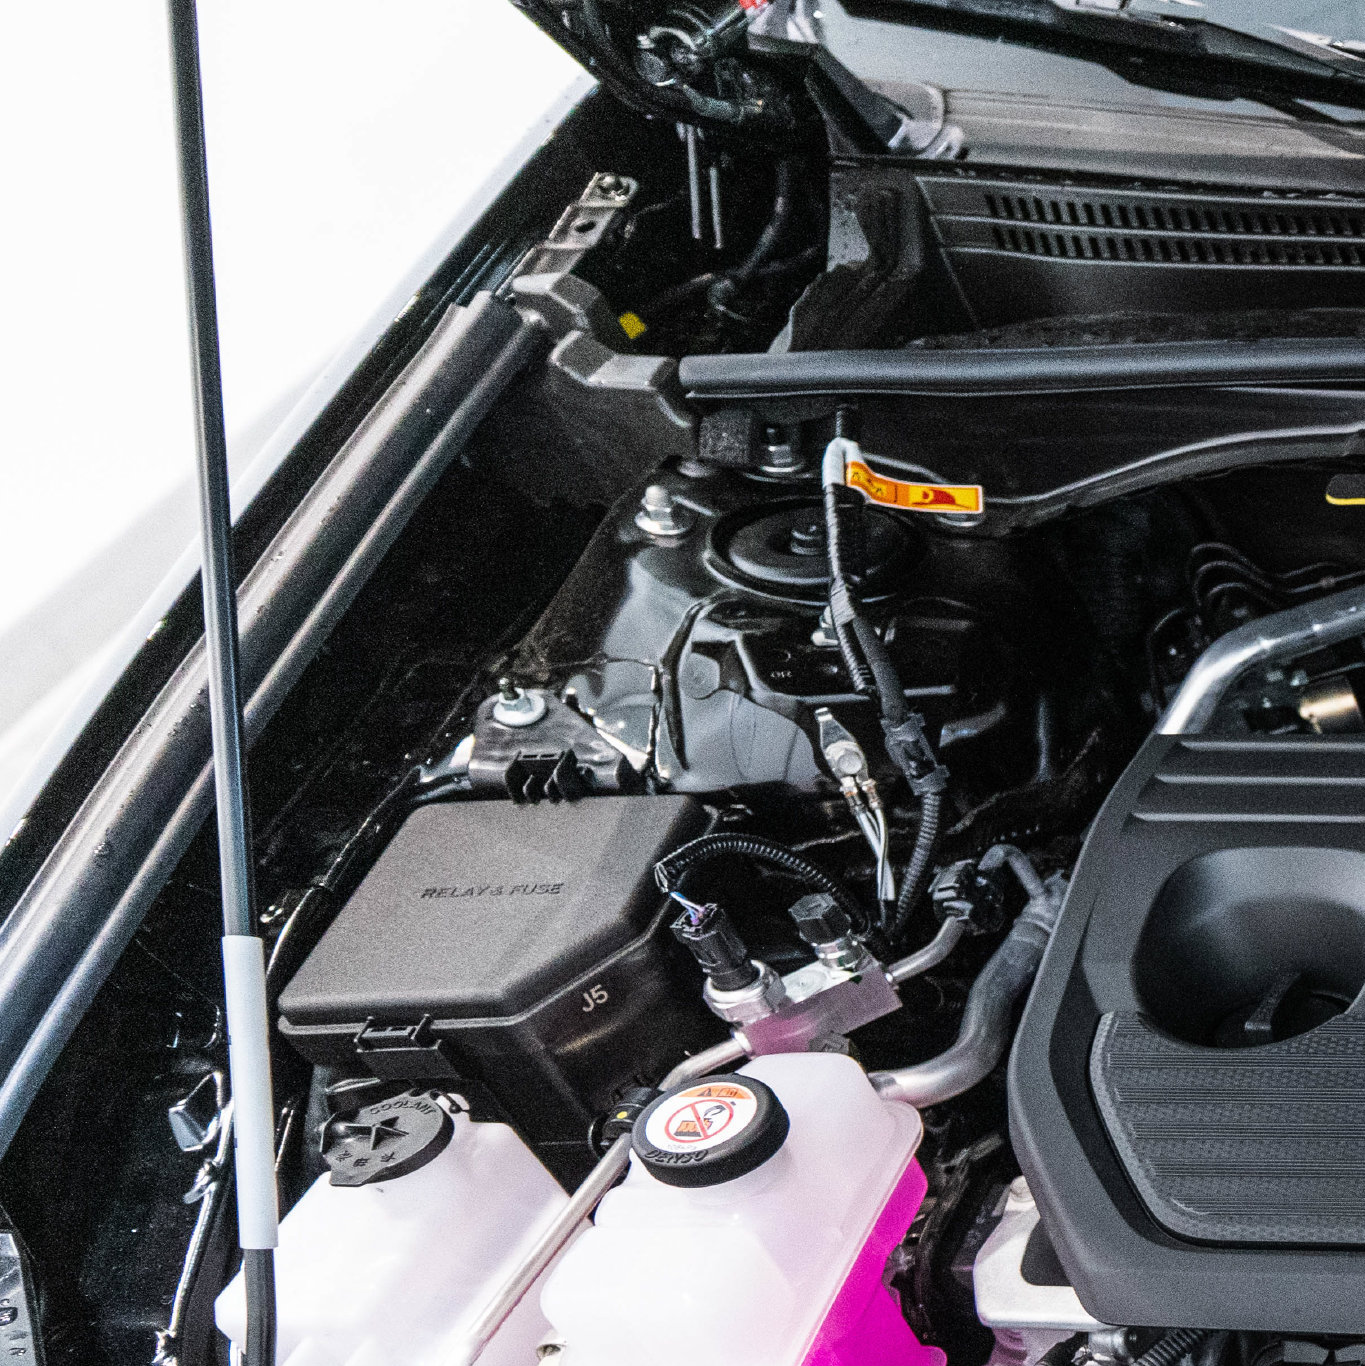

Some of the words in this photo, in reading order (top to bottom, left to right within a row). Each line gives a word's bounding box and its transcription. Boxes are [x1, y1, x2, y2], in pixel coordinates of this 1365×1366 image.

[420, 884, 490, 899] RELAY
[508, 882, 565, 897] FUSE
[581, 984, 609, 1012] J5
[370, 1100, 437, 1115] COOLANT
[644, 1149, 709, 1164] DENSO
